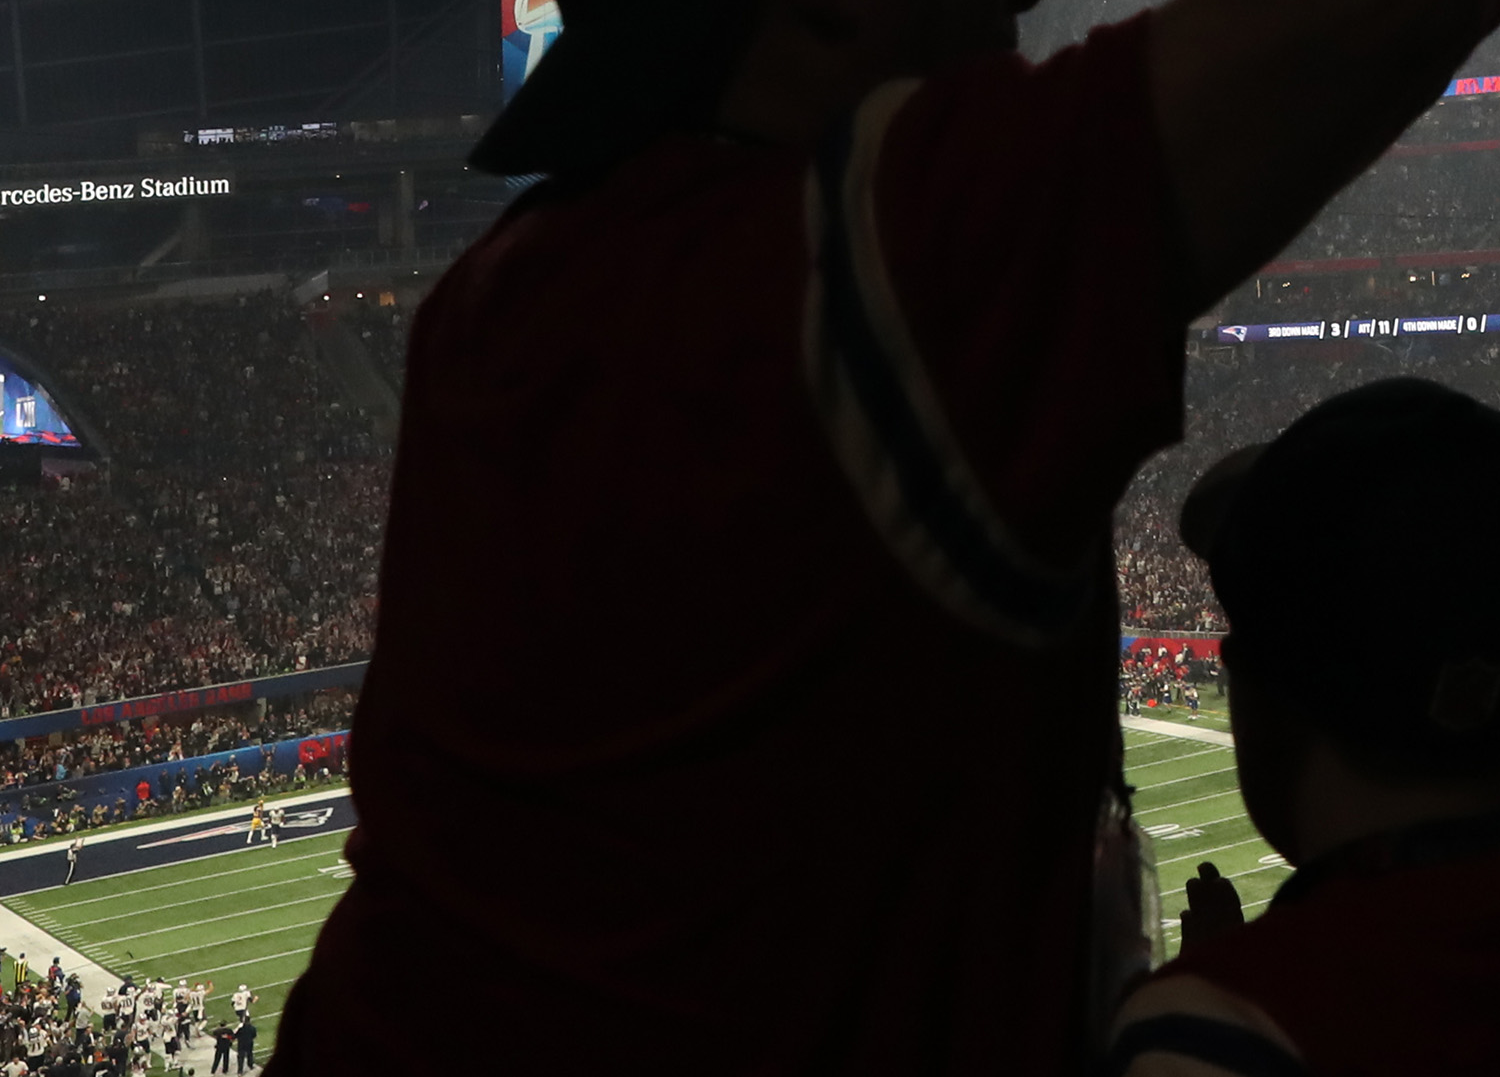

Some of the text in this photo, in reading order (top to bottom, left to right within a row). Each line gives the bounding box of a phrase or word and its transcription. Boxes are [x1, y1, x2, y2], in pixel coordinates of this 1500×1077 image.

[0, 174, 231, 205] rcedes-Benz Stadium
[1268, 327, 1281, 337] 3RD
[1282, 326, 1301, 336] DOWN
[1301, 325, 1320, 336] MADE
[1331, 323, 1341, 337] 3
[1378, 320, 1390, 334] 11
[1416, 320, 1437, 331] DOWN
[1438, 319, 1457, 330] MADE
[1466, 317, 1477, 331] 0
